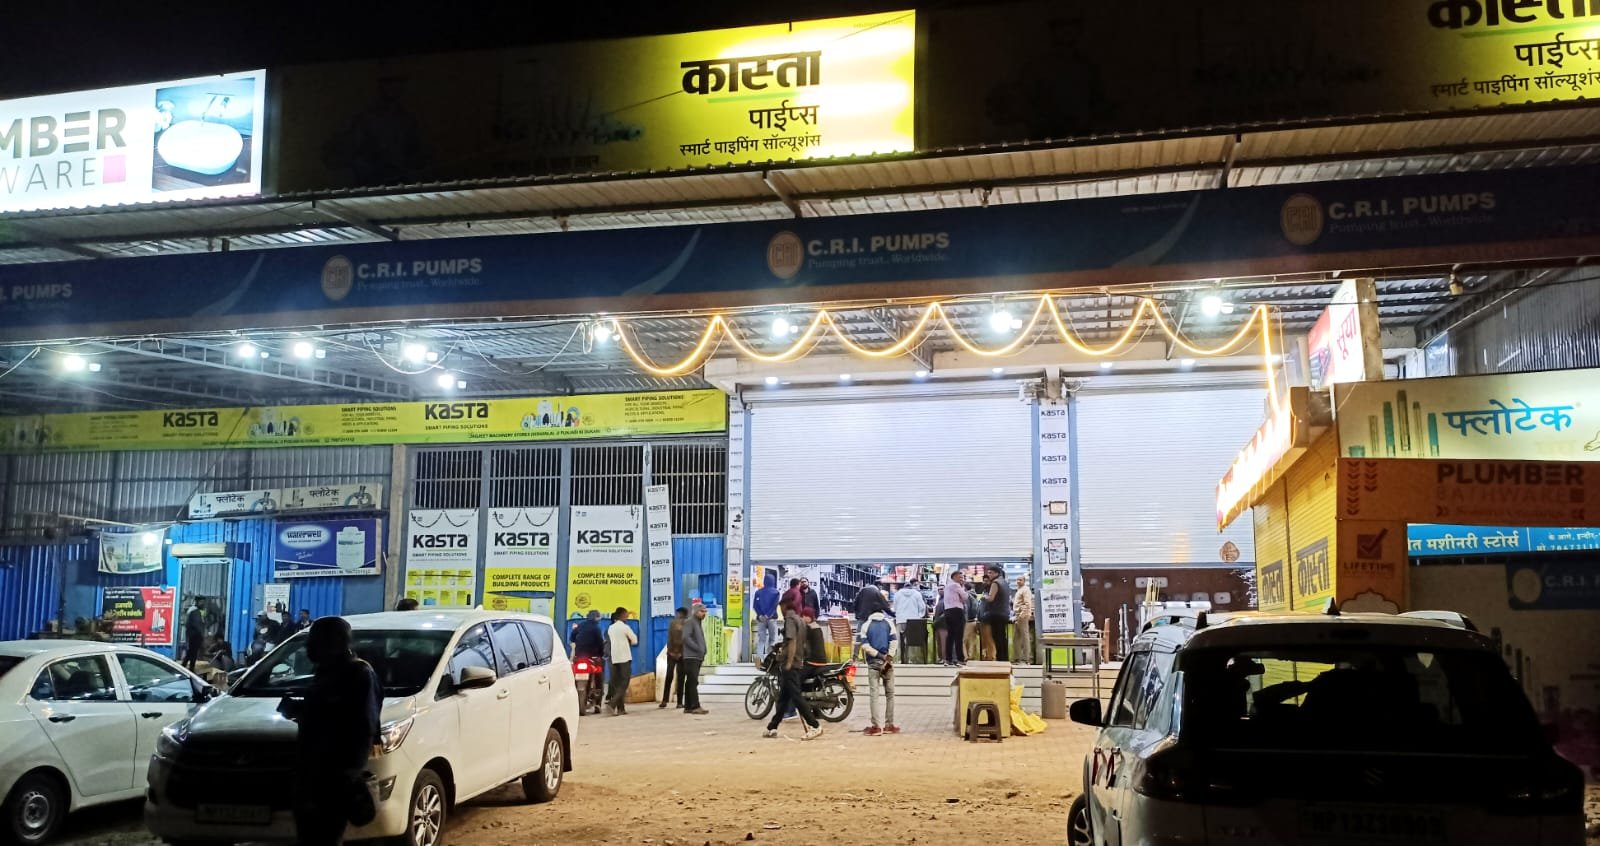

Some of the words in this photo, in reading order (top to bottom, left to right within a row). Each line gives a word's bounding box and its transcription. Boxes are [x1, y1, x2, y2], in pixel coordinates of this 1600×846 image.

[681, 50, 822, 95] कास्ता
[1474, 74, 1530, 96] पाइपिंग
[749, 99, 820, 132] पाईप्स
[680, 136, 711, 156] स्मार्ट
[715, 135, 759, 154] पाइपिंग
[763, 131, 822, 152] सॉल्यूशंस
[1328, 199, 1396, 220] C.R.I.
[1402, 191, 1496, 215] PUMPS
[807, 237, 865, 256] C.R.I.
[870, 232, 950, 252] PUMPS
[357, 262, 407, 279] C.R.I.
[412, 257, 483, 277] PUMPS
[11, 283, 72, 300] PUMPS
[1442, 397, 1575, 437] फ्लोटेक
[1436, 462, 1585, 486] PLUMBER
[1427, 533, 1478, 551] मशीनरी
[1483, 530, 1520, 549] स्टोर्स
